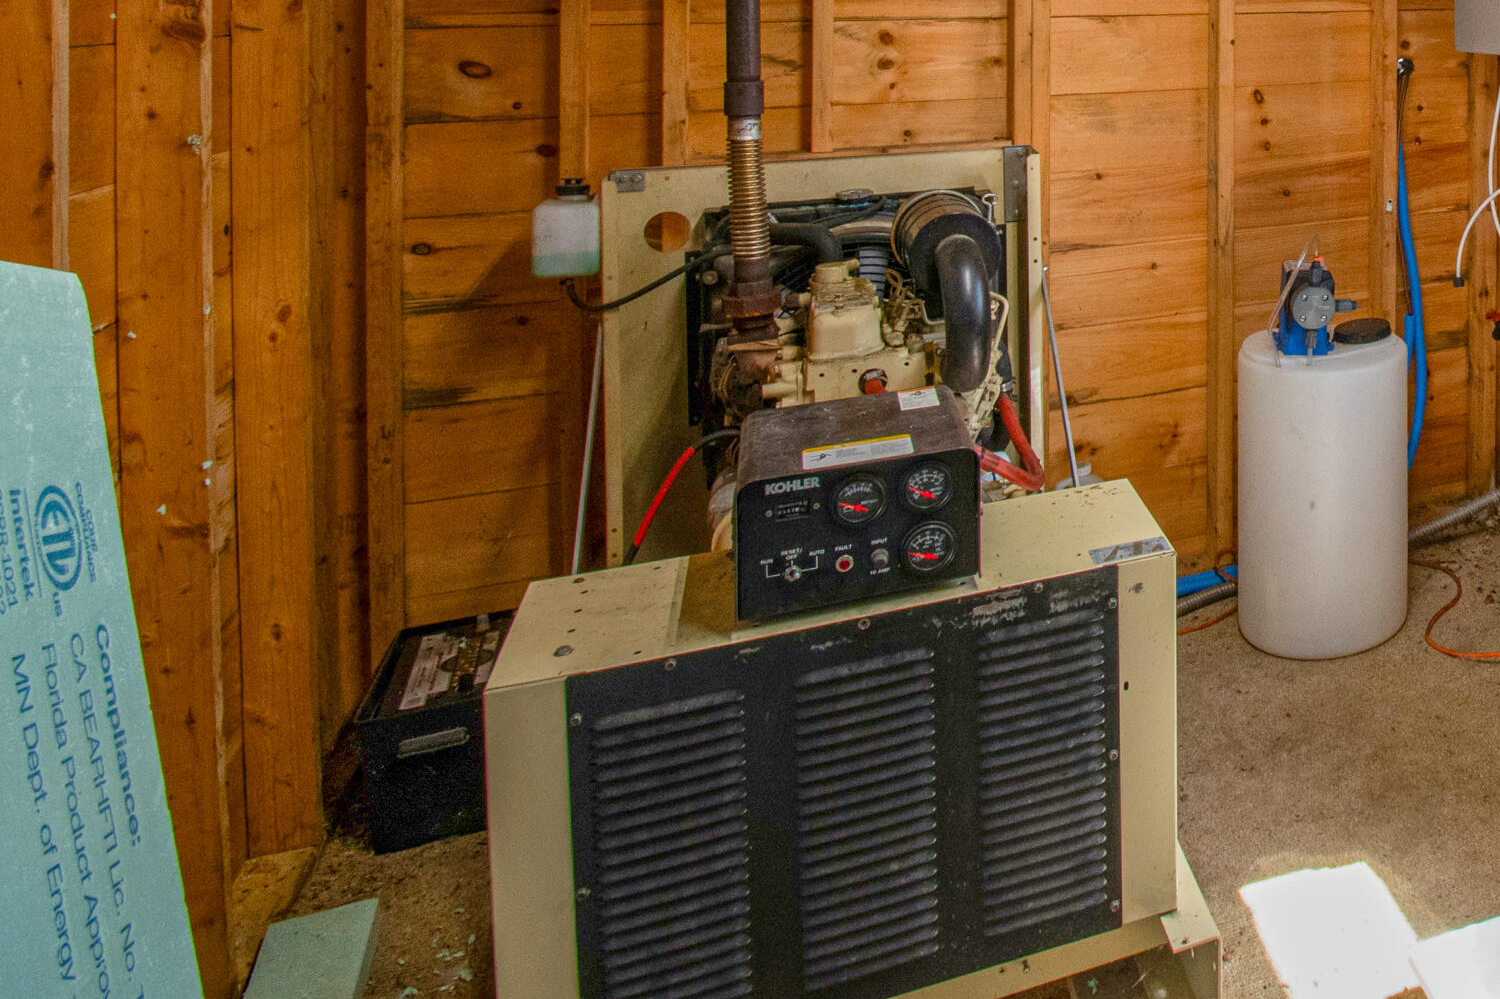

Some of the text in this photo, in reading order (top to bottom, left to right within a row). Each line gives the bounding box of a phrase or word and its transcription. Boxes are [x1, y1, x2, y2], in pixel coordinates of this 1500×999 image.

[9, 489, 34, 601] Intertek
[764, 476, 821, 496] KOHLER
[835, 544, 852, 552] FAULT
[12, 653, 77, 982] MN Dept. of Energy
[42, 642, 68, 750] Florida
[60, 754, 94, 884] Product
[70, 632, 88, 684] CA
[108, 859, 126, 917] Lic.
[119, 923, 137, 982] No.
[95, 624, 142, 847] Compliance:
